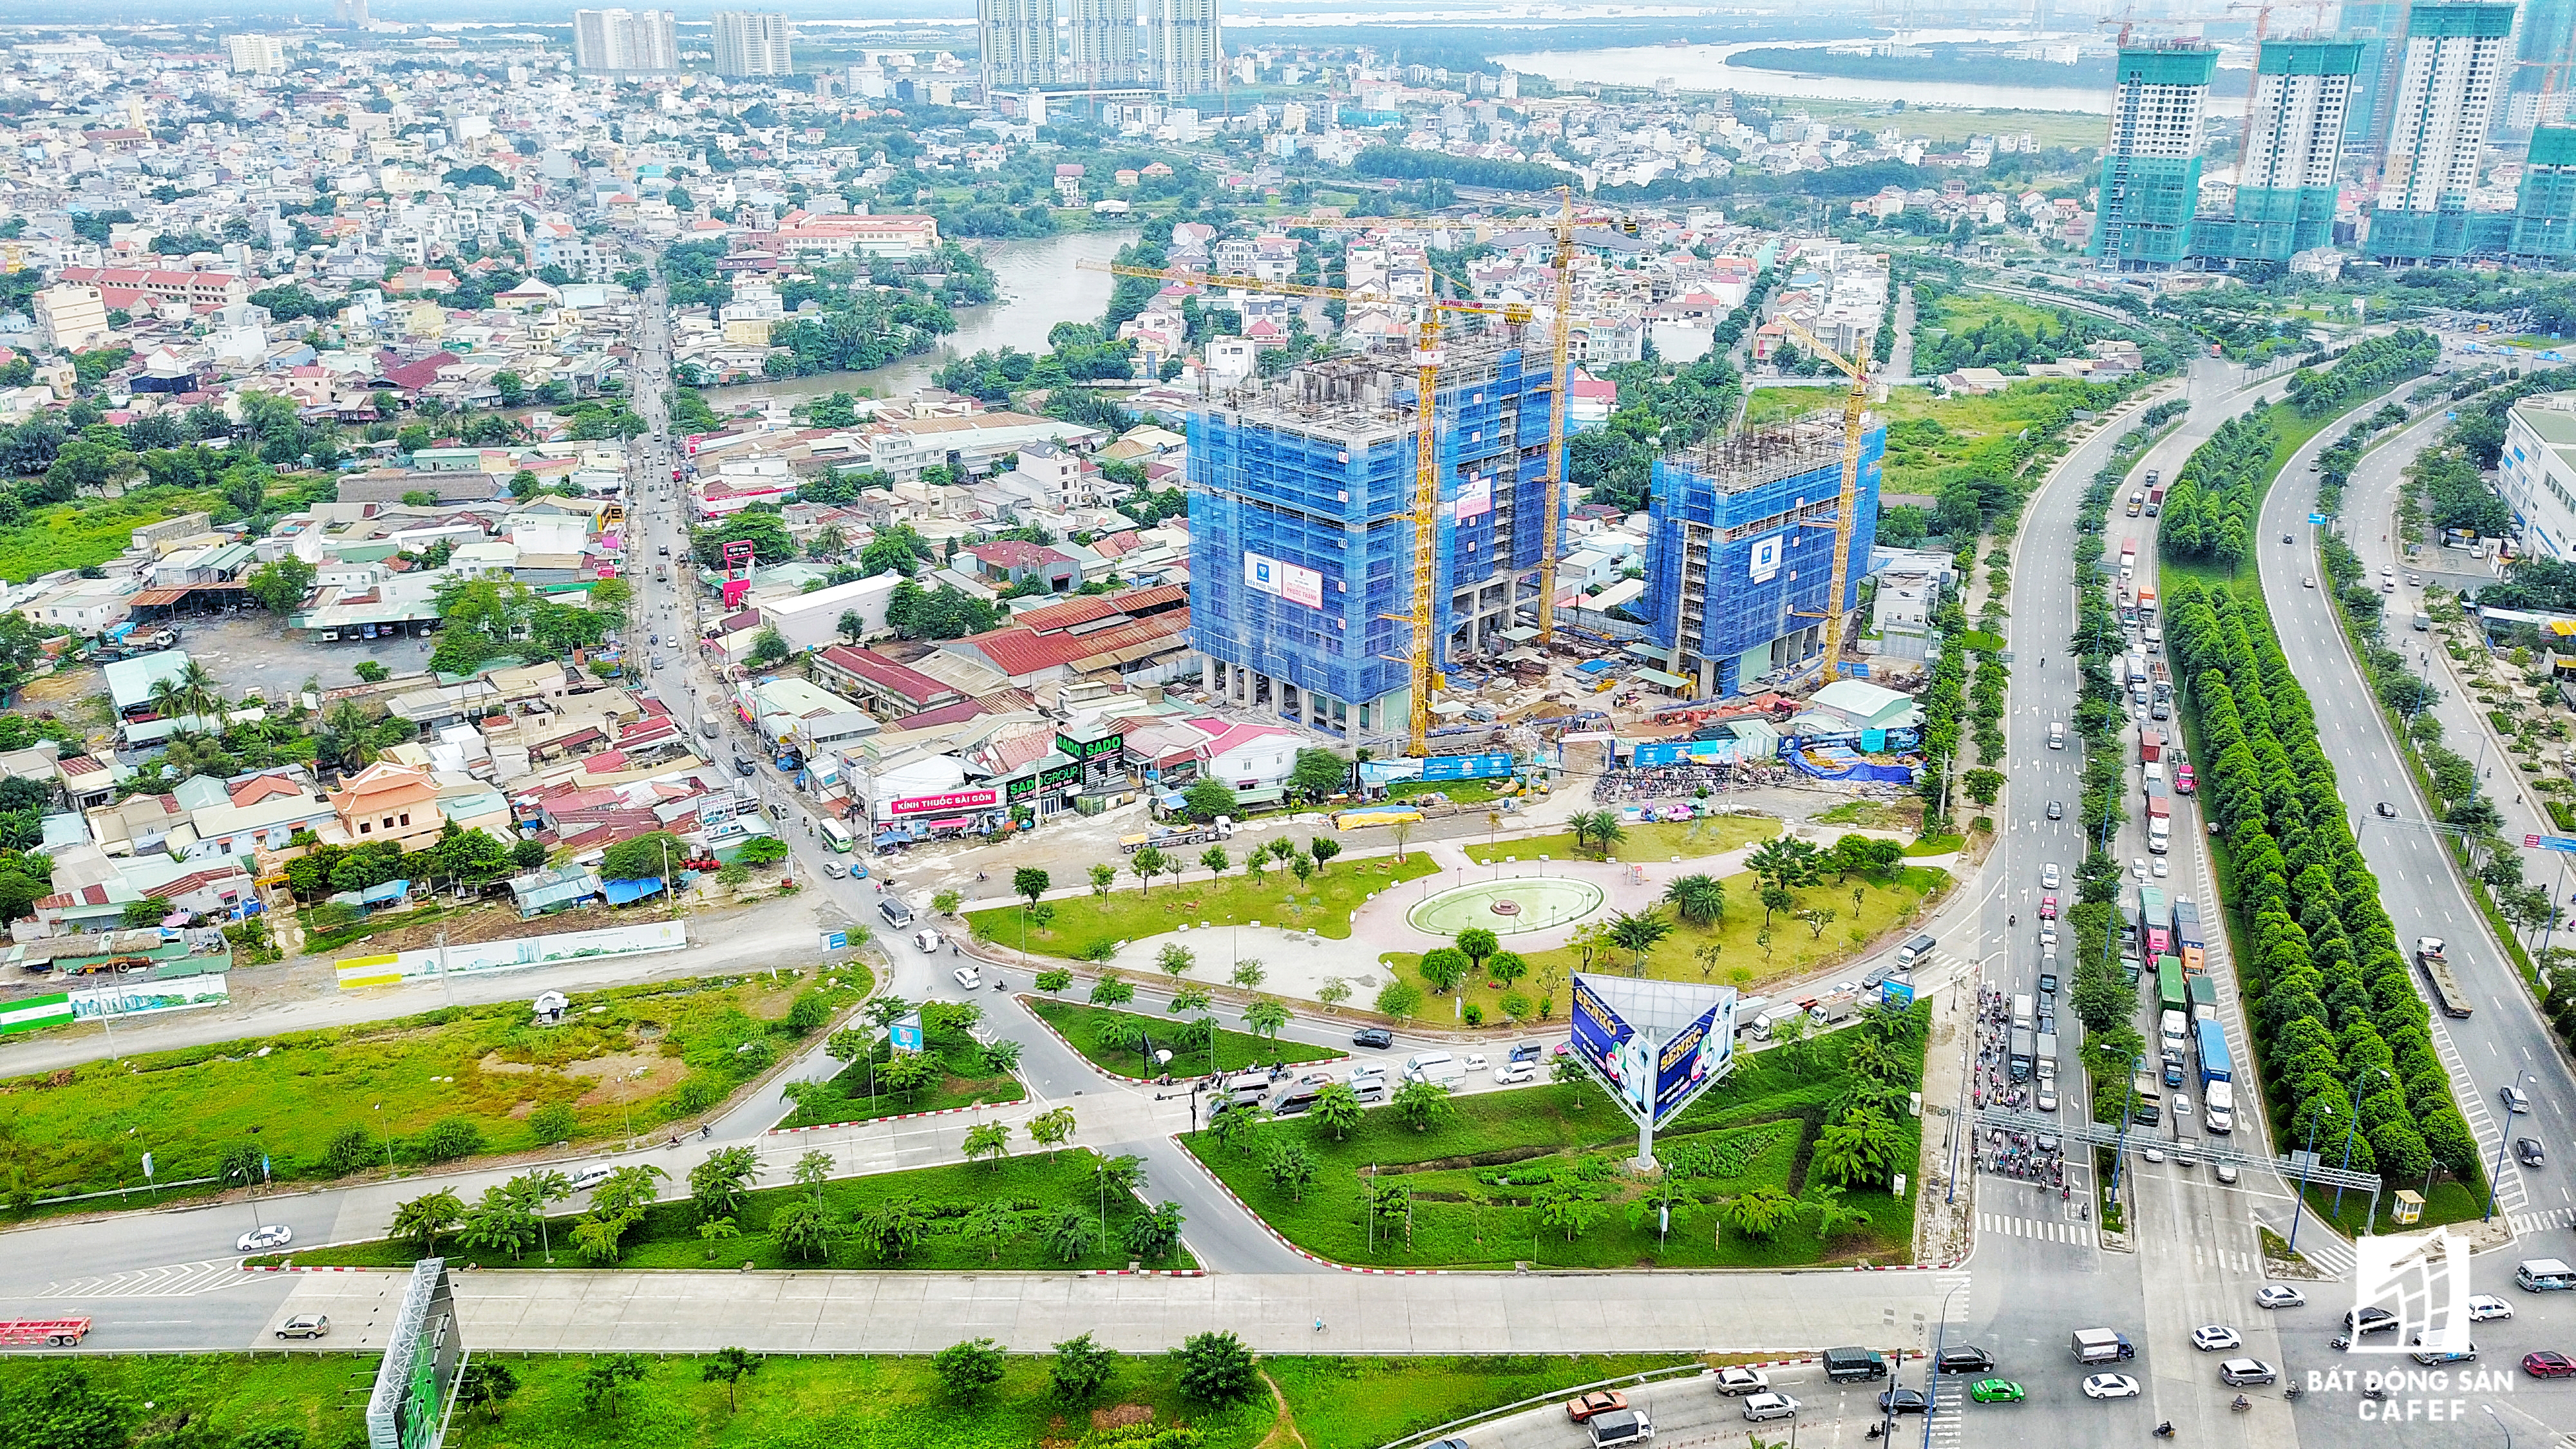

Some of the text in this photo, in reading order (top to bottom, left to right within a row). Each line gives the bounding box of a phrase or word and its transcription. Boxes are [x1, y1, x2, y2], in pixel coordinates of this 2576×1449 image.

[1339, 453, 1348, 462] 14
[1339, 492, 1347, 501] 12
[1339, 539, 1347, 547] 10
[1057, 735, 1081, 757] SADO
[1086, 736, 1121, 756] SADO
[1044, 766, 1078, 785] GROUP
[897, 793, 992, 810] KÍNH THUỐC SÀI GÒN
[1575, 988, 1618, 1036] SENKO
